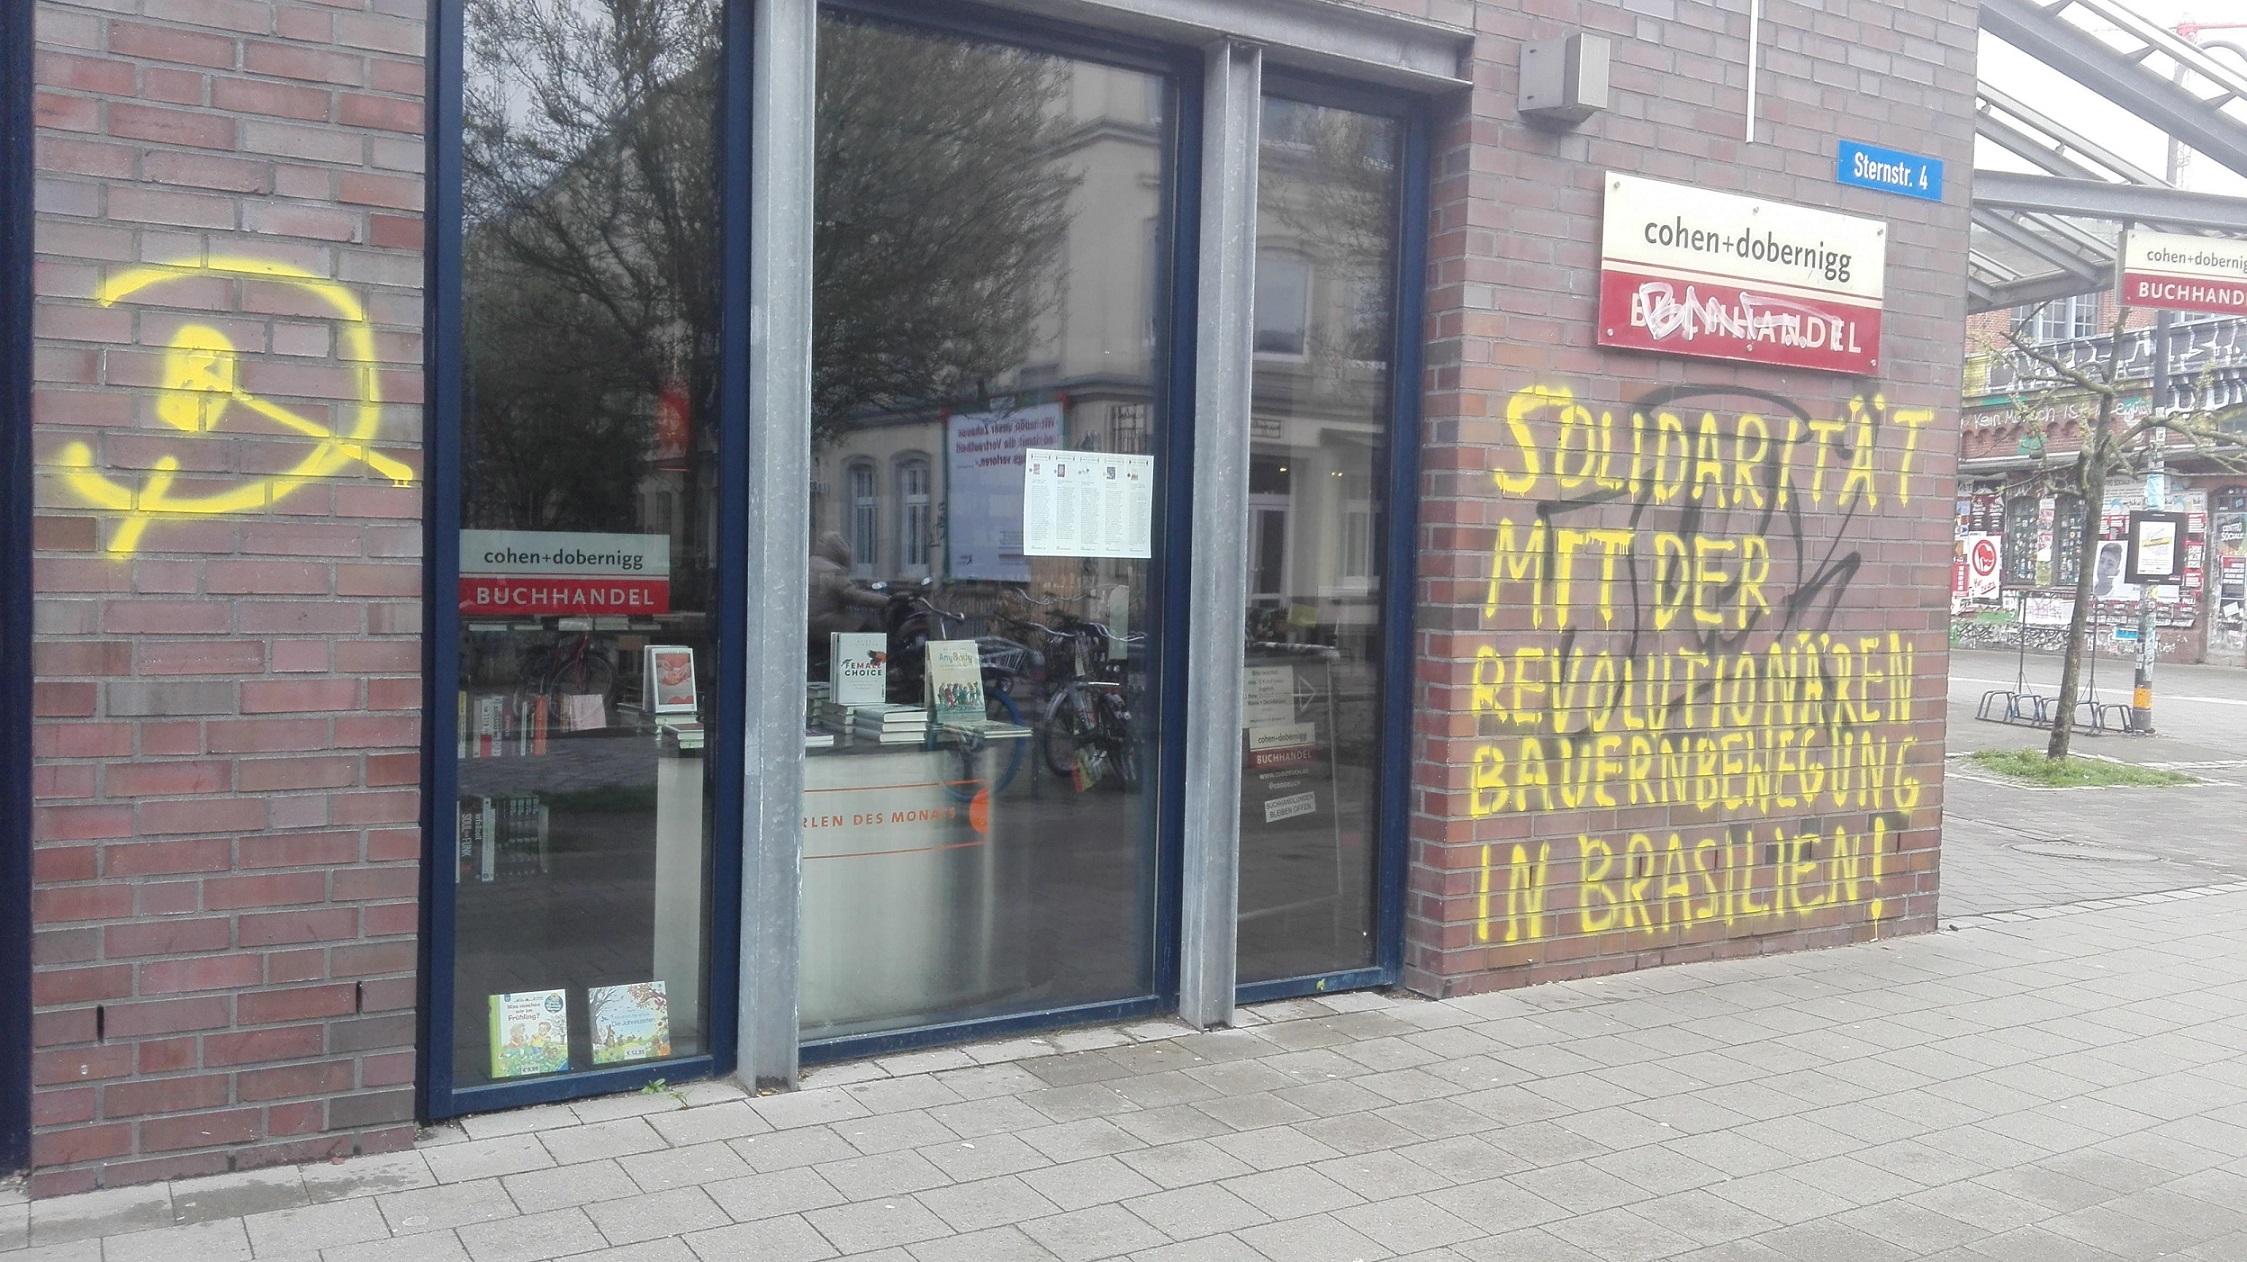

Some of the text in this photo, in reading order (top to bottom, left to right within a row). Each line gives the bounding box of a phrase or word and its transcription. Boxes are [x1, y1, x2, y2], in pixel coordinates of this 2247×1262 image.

[1854, 151, 1928, 190] Sternstr. 4
[1645, 216, 1852, 283] cohen+dobernigg
[2139, 281, 2247, 306] BUCHHAND
[1630, 292, 1861, 354] BUHHANDEL
[1494, 385, 1935, 509] SOLIDARITÄT
[484, 548, 643, 570] cohen+dobernigg
[476, 587, 655, 606] BUCHHANDEL
[1654, 532, 1771, 630] DER
[844, 669, 883, 677] CHOICE
[1471, 631, 1914, 733] REVOLUTIONÄREN
[1256, 750, 1312, 765] BUCHHANDEL
[853, 812, 883, 826] DES
[1477, 841, 1550, 942] IN
